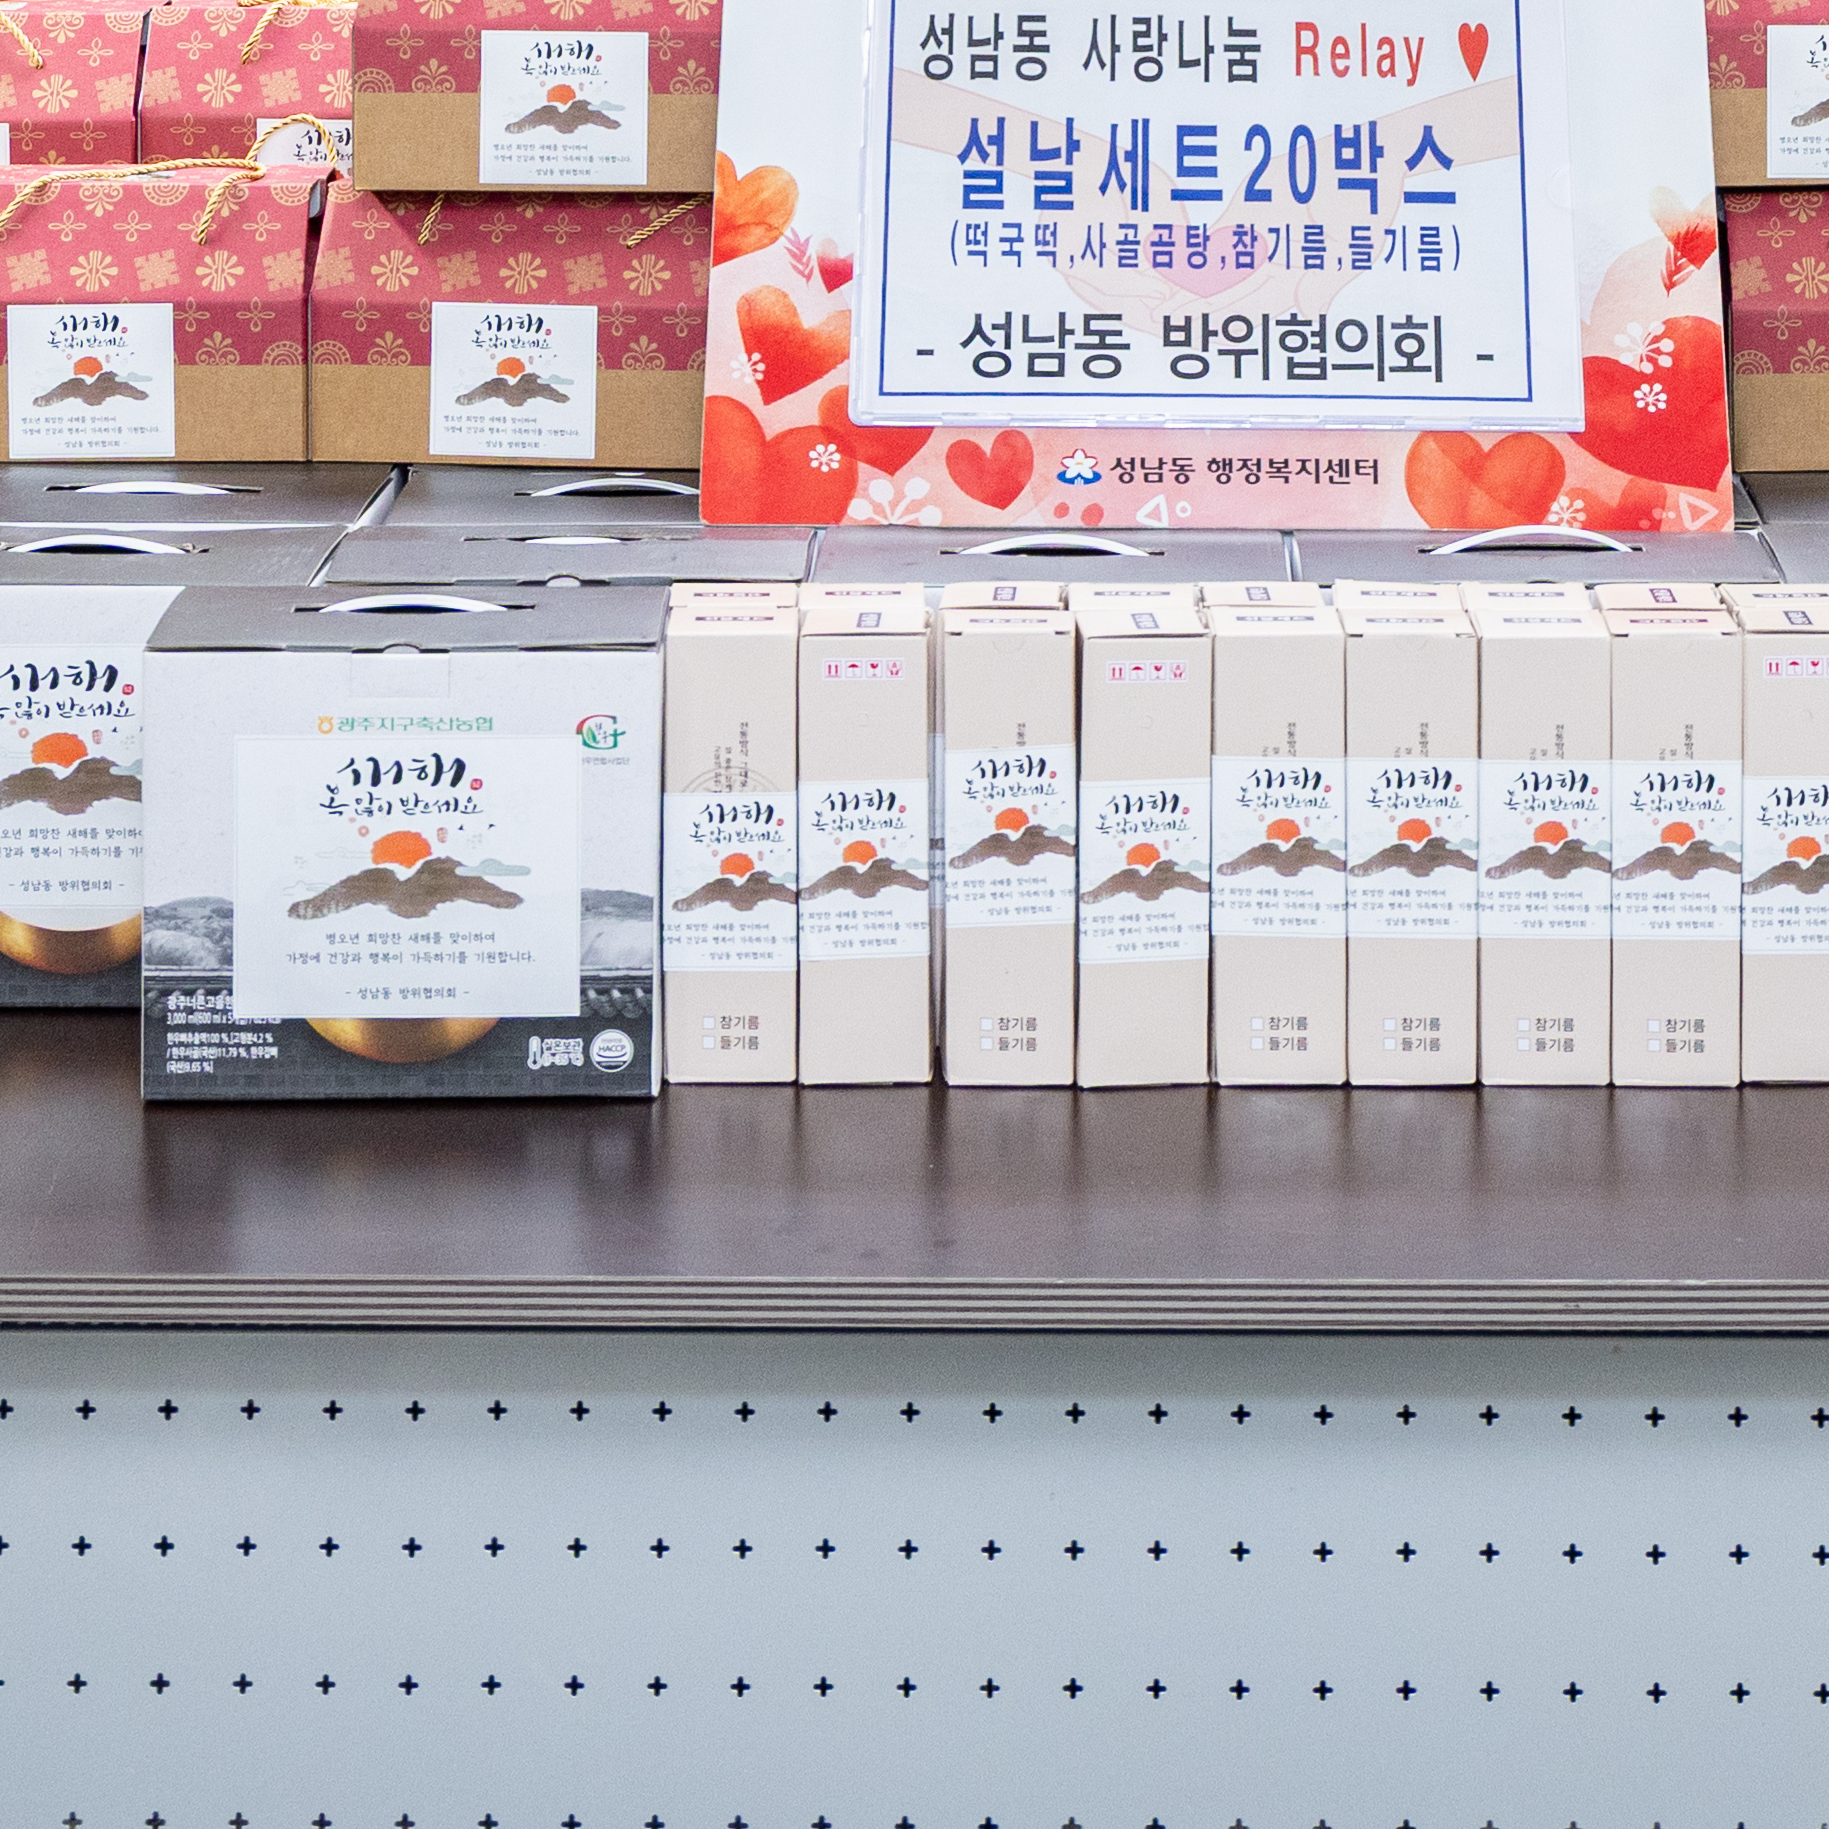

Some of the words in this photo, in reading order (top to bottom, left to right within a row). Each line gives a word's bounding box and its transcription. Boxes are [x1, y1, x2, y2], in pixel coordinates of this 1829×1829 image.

[531, 40, 593, 60] 새해
[920, 13, 1050, 82] 성남동
[1083, 14, 1262, 83] 사랑나눔
[1294, 21, 1424, 86] Relay
[957, 116, 1456, 214] 설날세트20박스
[57, 312, 119, 332] 새해
[481, 313, 544, 333] 새해
[959, 311, 1131, 379] 성남동
[1162, 312, 1443, 383] 방위협의회
[1110, 457, 1195, 484] 성남동
[1207, 458, 1379, 485] 행정복지센터
[15, 696, 49, 719] 많이
[56, 697, 135, 718] 받으세요
[338, 716, 493, 732] 광주지구축산농협
[337, 753, 466, 787] 새해
[972, 755, 1047, 780] 새해
[1247, 766, 1322, 790] 새해
[1377, 766, 1452, 790] 새해
[1514, 770, 1589, 793] 새해
[1640, 770, 1715, 793] 새해
[320, 784, 349, 816] 복
[355, 791, 392, 817] 많이
[400, 793, 483, 815] 받으세요
[821, 788, 896, 813] 새해
[1105, 791, 1180, 816] 새해
[699, 802, 774, 825] 새해
[29, 828, 60, 839] 희망찬
[67, 828, 99, 839] 새해를
[31, 847, 61, 857] 행복이
[70, 847, 122, 858] 가득하기를
[20, 879, 52, 891] 성남동
[59, 879, 112, 891] 방위협의회
[326, 933, 359, 944] 병오년
[367, 932, 401, 944] 희망찬
[408, 932, 442, 945] 새해를
[450, 932, 495, 944] 맞이하여
[285, 952, 320, 964] 가정에
[328, 952, 362, 964] 건강과
[370, 952, 403, 964] 행복이
[412, 952, 467, 964] 가득하기를
[357, 987, 391, 999] 성남동
[399, 987, 456, 999] 방위협의회
[720, 1015, 759, 1030] 참기름
[998, 1017, 1037, 1031] 참기름
[1268, 1017, 1308, 1031] 참기름
[1401, 1017, 1441, 1031] 참기름
[1535, 1018, 1574, 1032] 참기름
[1666, 1019, 1705, 1033] 참기름
[720, 1036, 759, 1050] 들기름
[998, 1037, 1037, 1051] 들기름
[1268, 1037, 1308, 1051] 들기름
[1401, 1038, 1441, 1052] 들기름
[1535, 1038, 1574, 1052] 들기름
[1666, 1039, 1705, 1053] 들기름
